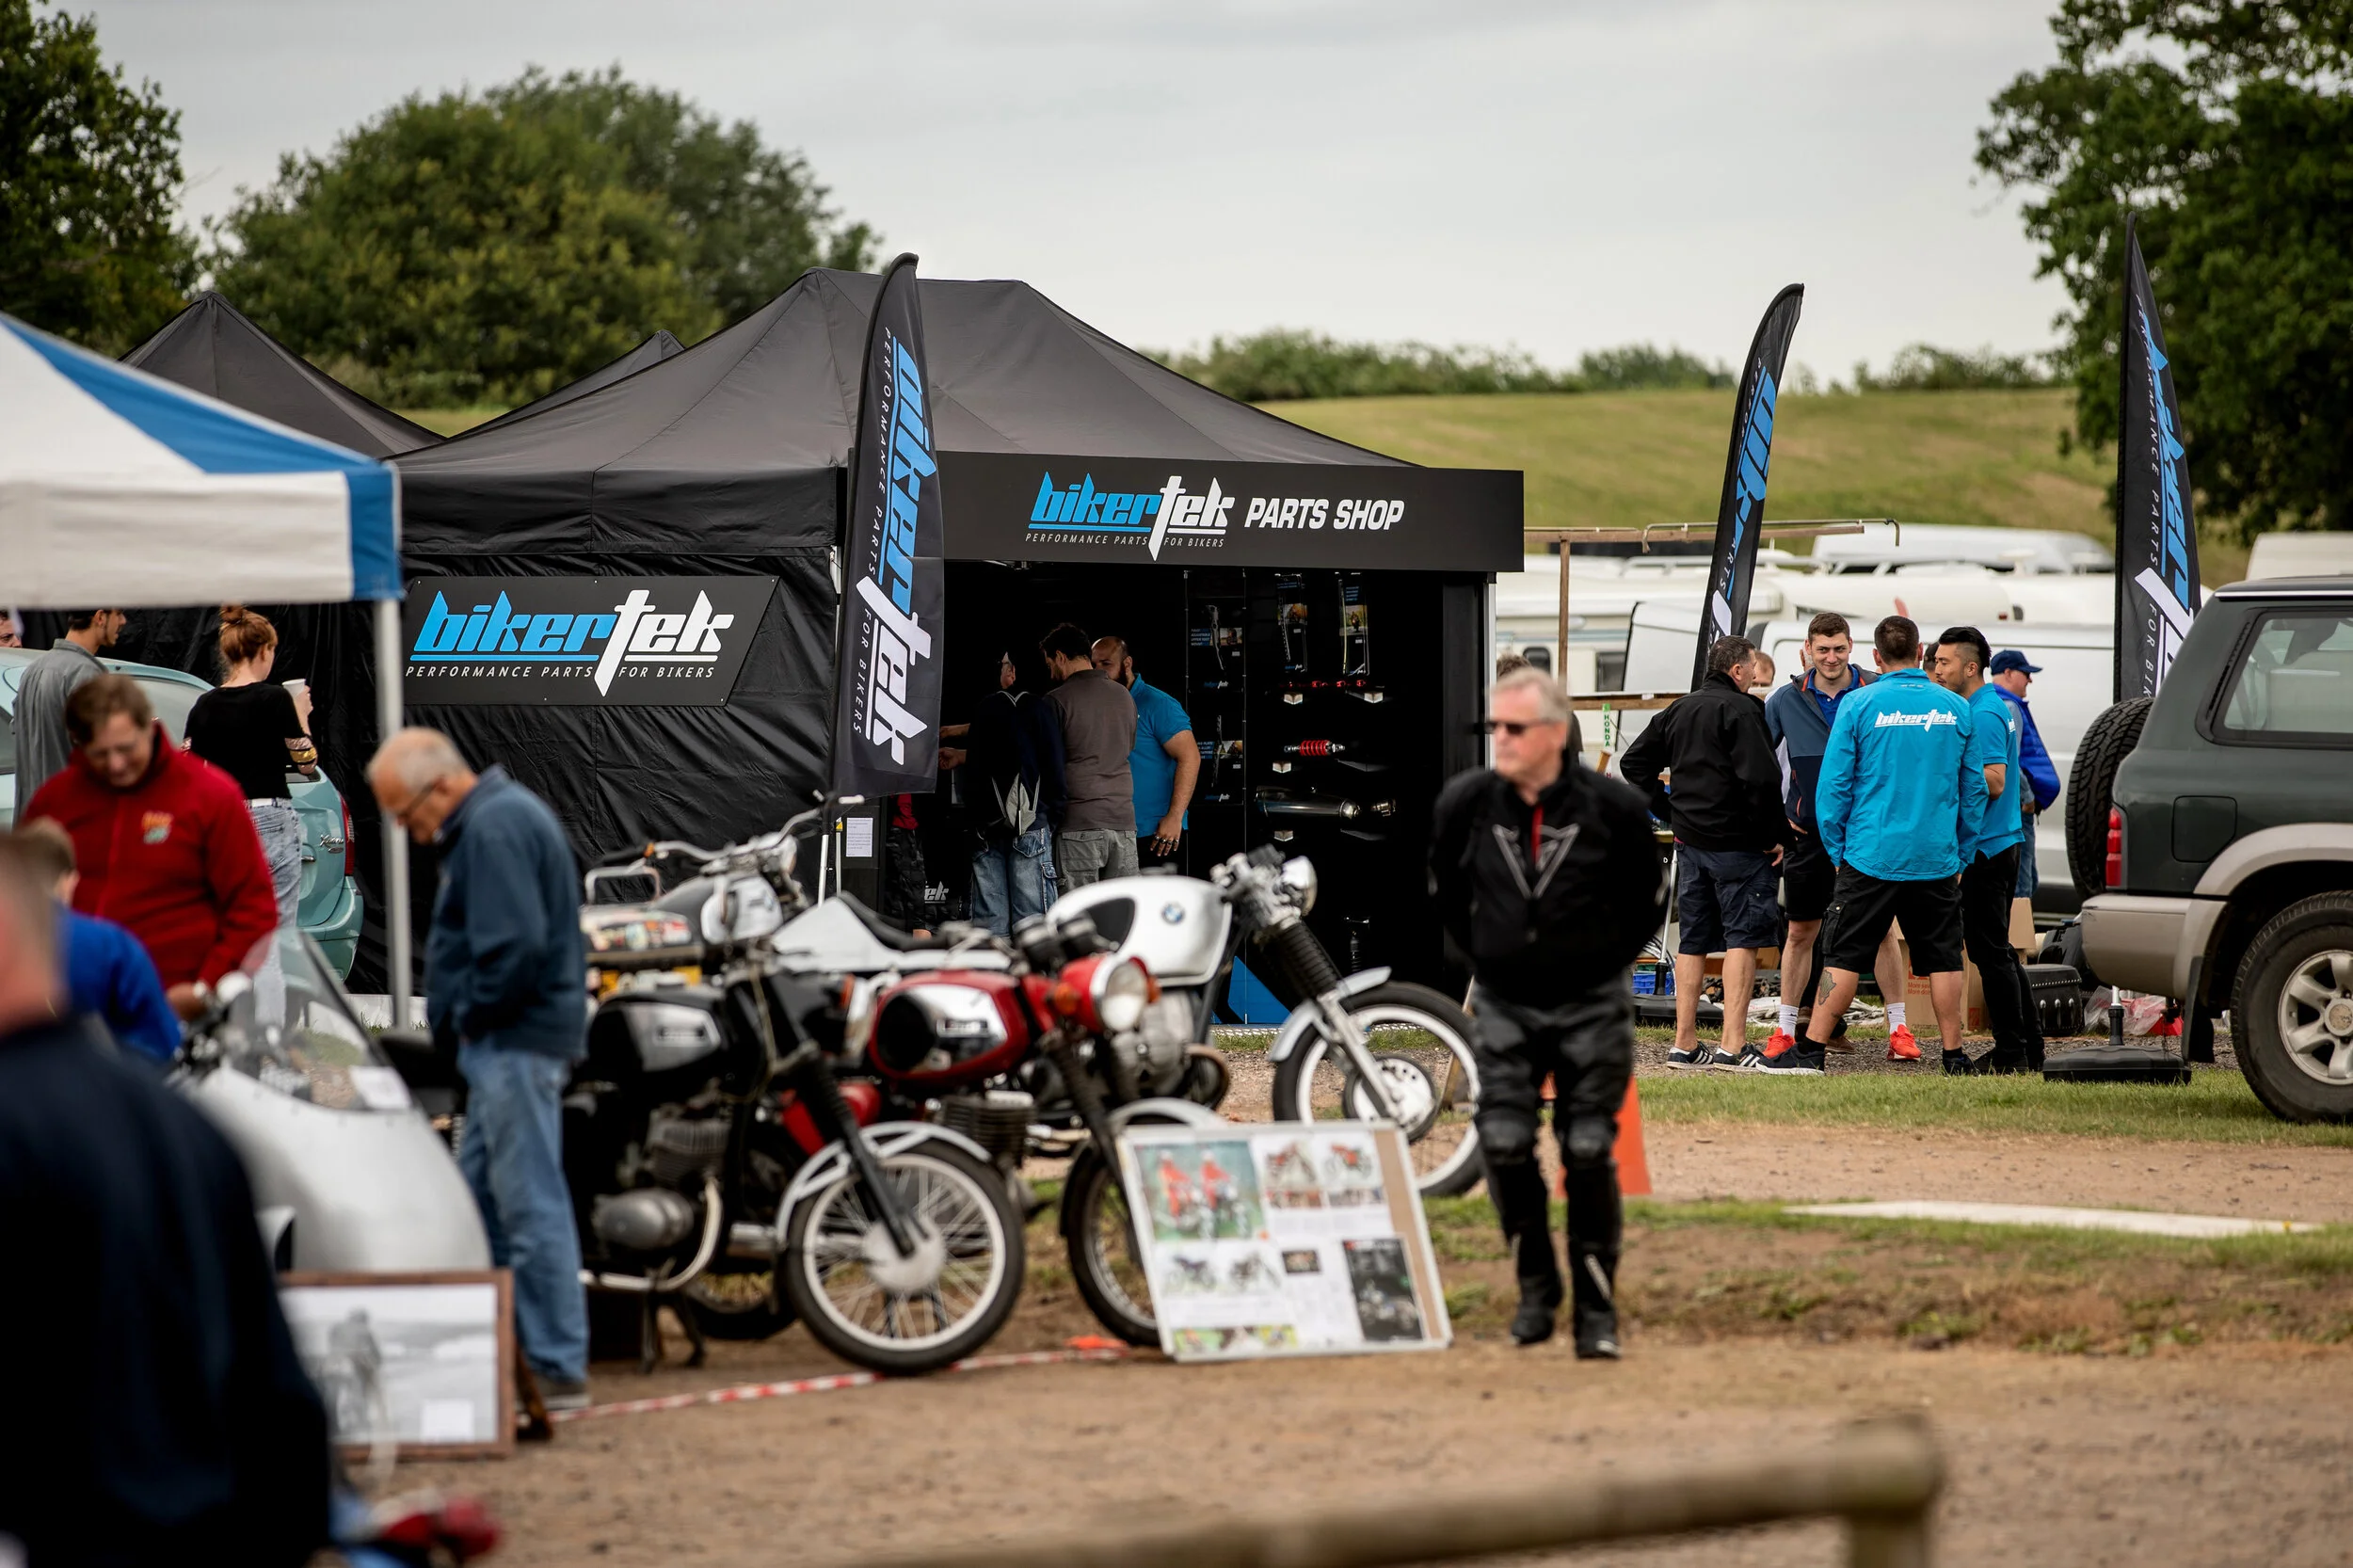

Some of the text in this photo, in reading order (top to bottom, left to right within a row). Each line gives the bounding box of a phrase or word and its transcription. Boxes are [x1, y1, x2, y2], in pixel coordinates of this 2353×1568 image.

[853, 327, 892, 734] PERFORMANCE PARTS FOR BIKERS
[856, 342, 936, 766] bikertek
[1025, 533, 1225, 548] PERFORMANCE PARTS FOR BIKERS
[1031, 471, 1405, 562] bikertek PARTS SHOP
[2151, 489, 2159, 566] PARTS
[1720, 537, 1737, 590] ARTS
[405, 665, 715, 679] PERFORMANCE PARTS FOR BIKERS
[413, 589, 735, 697] bikertek
[2143, 602, 2157, 697] FOR BIK
[1875, 709, 1958, 733] bikertek
